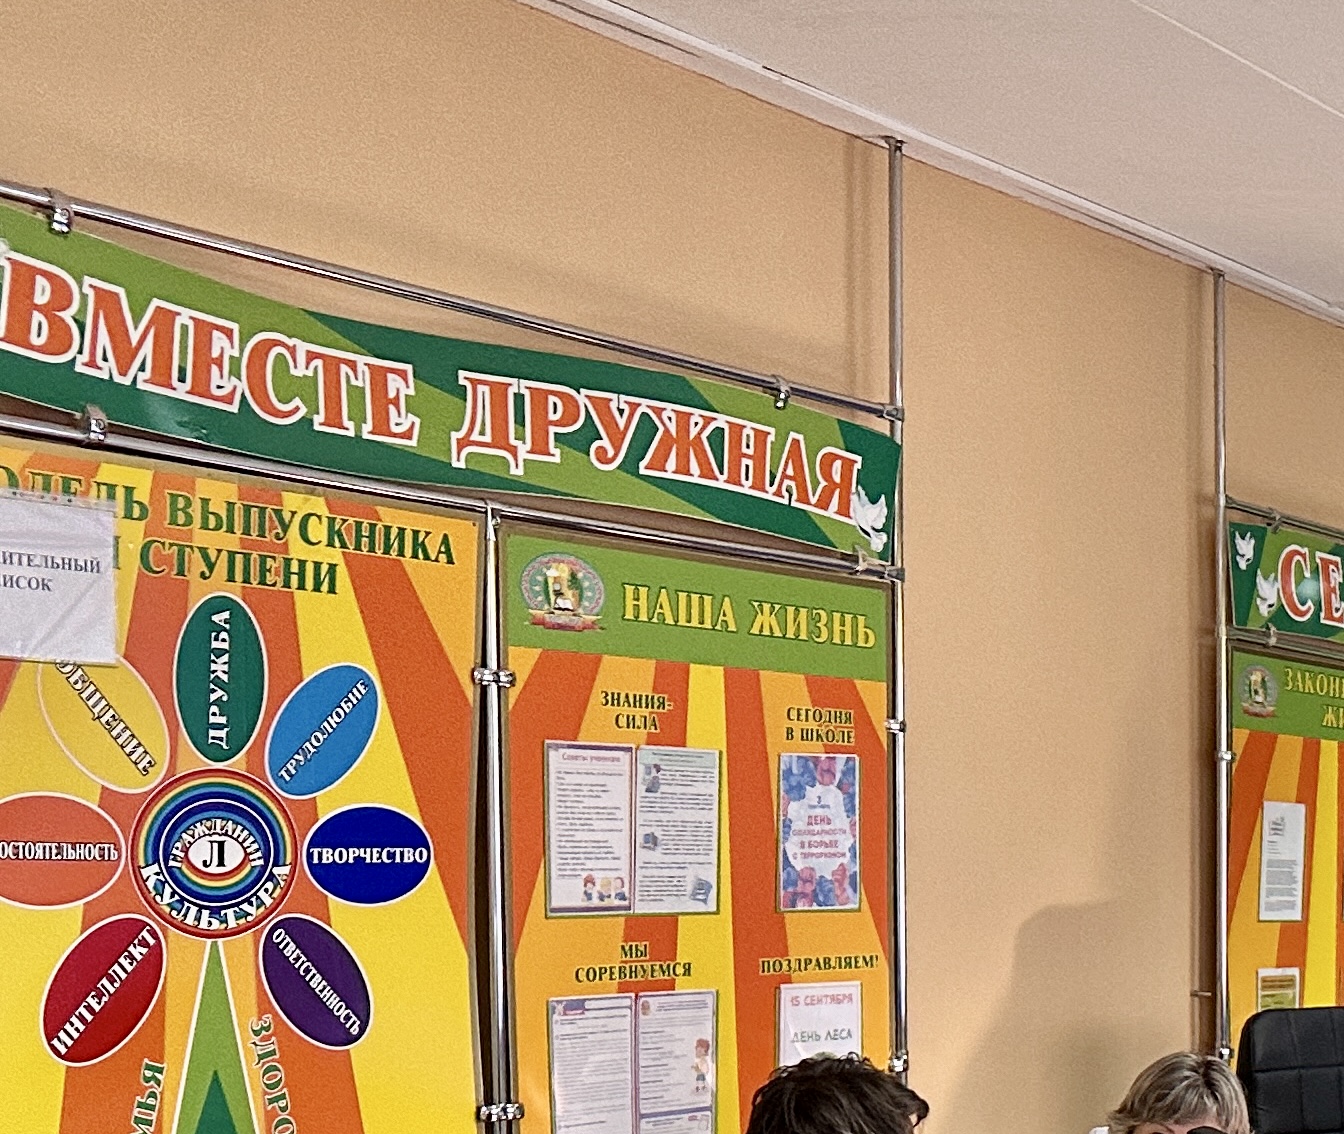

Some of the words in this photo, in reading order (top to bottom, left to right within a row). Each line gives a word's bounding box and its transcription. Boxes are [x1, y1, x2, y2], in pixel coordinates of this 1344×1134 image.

[0, 250, 421, 447] ВМЕСТЕ
[450, 370, 862, 521] ДРУЖНАЯ
[167, 489, 457, 567] ВЫПУСКНИКА
[138, 537, 339, 596] СТУПЕНИ
[621, 582, 738, 634] НАША
[748, 599, 878, 650] ЖИЗНЬ
[207, 608, 232, 750] ДРУЖБА
[54, 659, 158, 777] ОБЩЕНИЕ
[600, 690, 673, 711] ЗНАНИЯ-
[785, 706, 853, 728] СЕГОДНЯ
[278, 678, 371, 784] ТРУДОЛЮБИЕ
[614, 712, 660, 732] СИЛА
[785, 726, 795, 742] В
[799, 727, 855, 745] ШКОЛЕ
[806, 814, 833, 827] ДЕНЬ
[167, 818, 265, 869] ГРАЖДАНИН
[202, 839, 227, 869] Л
[309, 846, 430, 865] ТВОРЧЕСТВО
[139, 861, 293, 932] КУЛЬТУРА
[620, 943, 648, 959] МЫ
[760, 954, 880, 975] ПОЗДРАВЛЯЕМ!
[50, 925, 158, 1058] ИНТЕЛЛЕКТ
[271, 927, 361, 1037] ОТВЕТСТВЕННОСТЬ
[574, 961, 693, 983] СОРЕВНУЕМСЯ
[790, 1030, 821, 1043] ДЕНЬ
[825, 1028, 852, 1041] ЛЕСА
